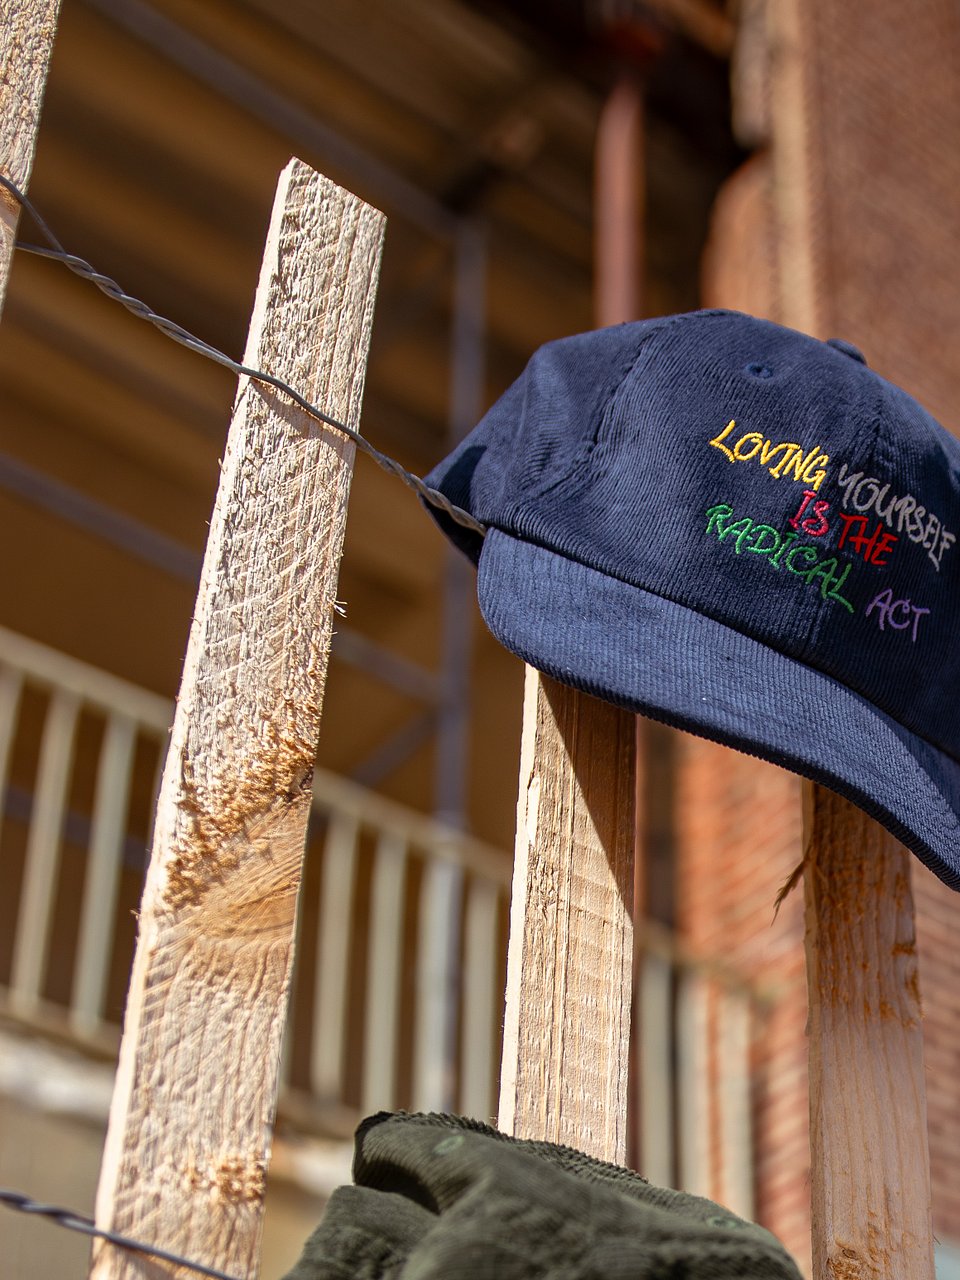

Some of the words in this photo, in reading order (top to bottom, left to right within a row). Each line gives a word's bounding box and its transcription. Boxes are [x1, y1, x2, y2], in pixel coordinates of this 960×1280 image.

[709, 419, 829, 491] LOVING
[837, 464, 956, 572] YOURSELF
[789, 489, 829, 536] IS
[839, 512, 898, 565] THE
[705, 504, 854, 613] RADICAL
[866, 588, 930, 642] ACT
